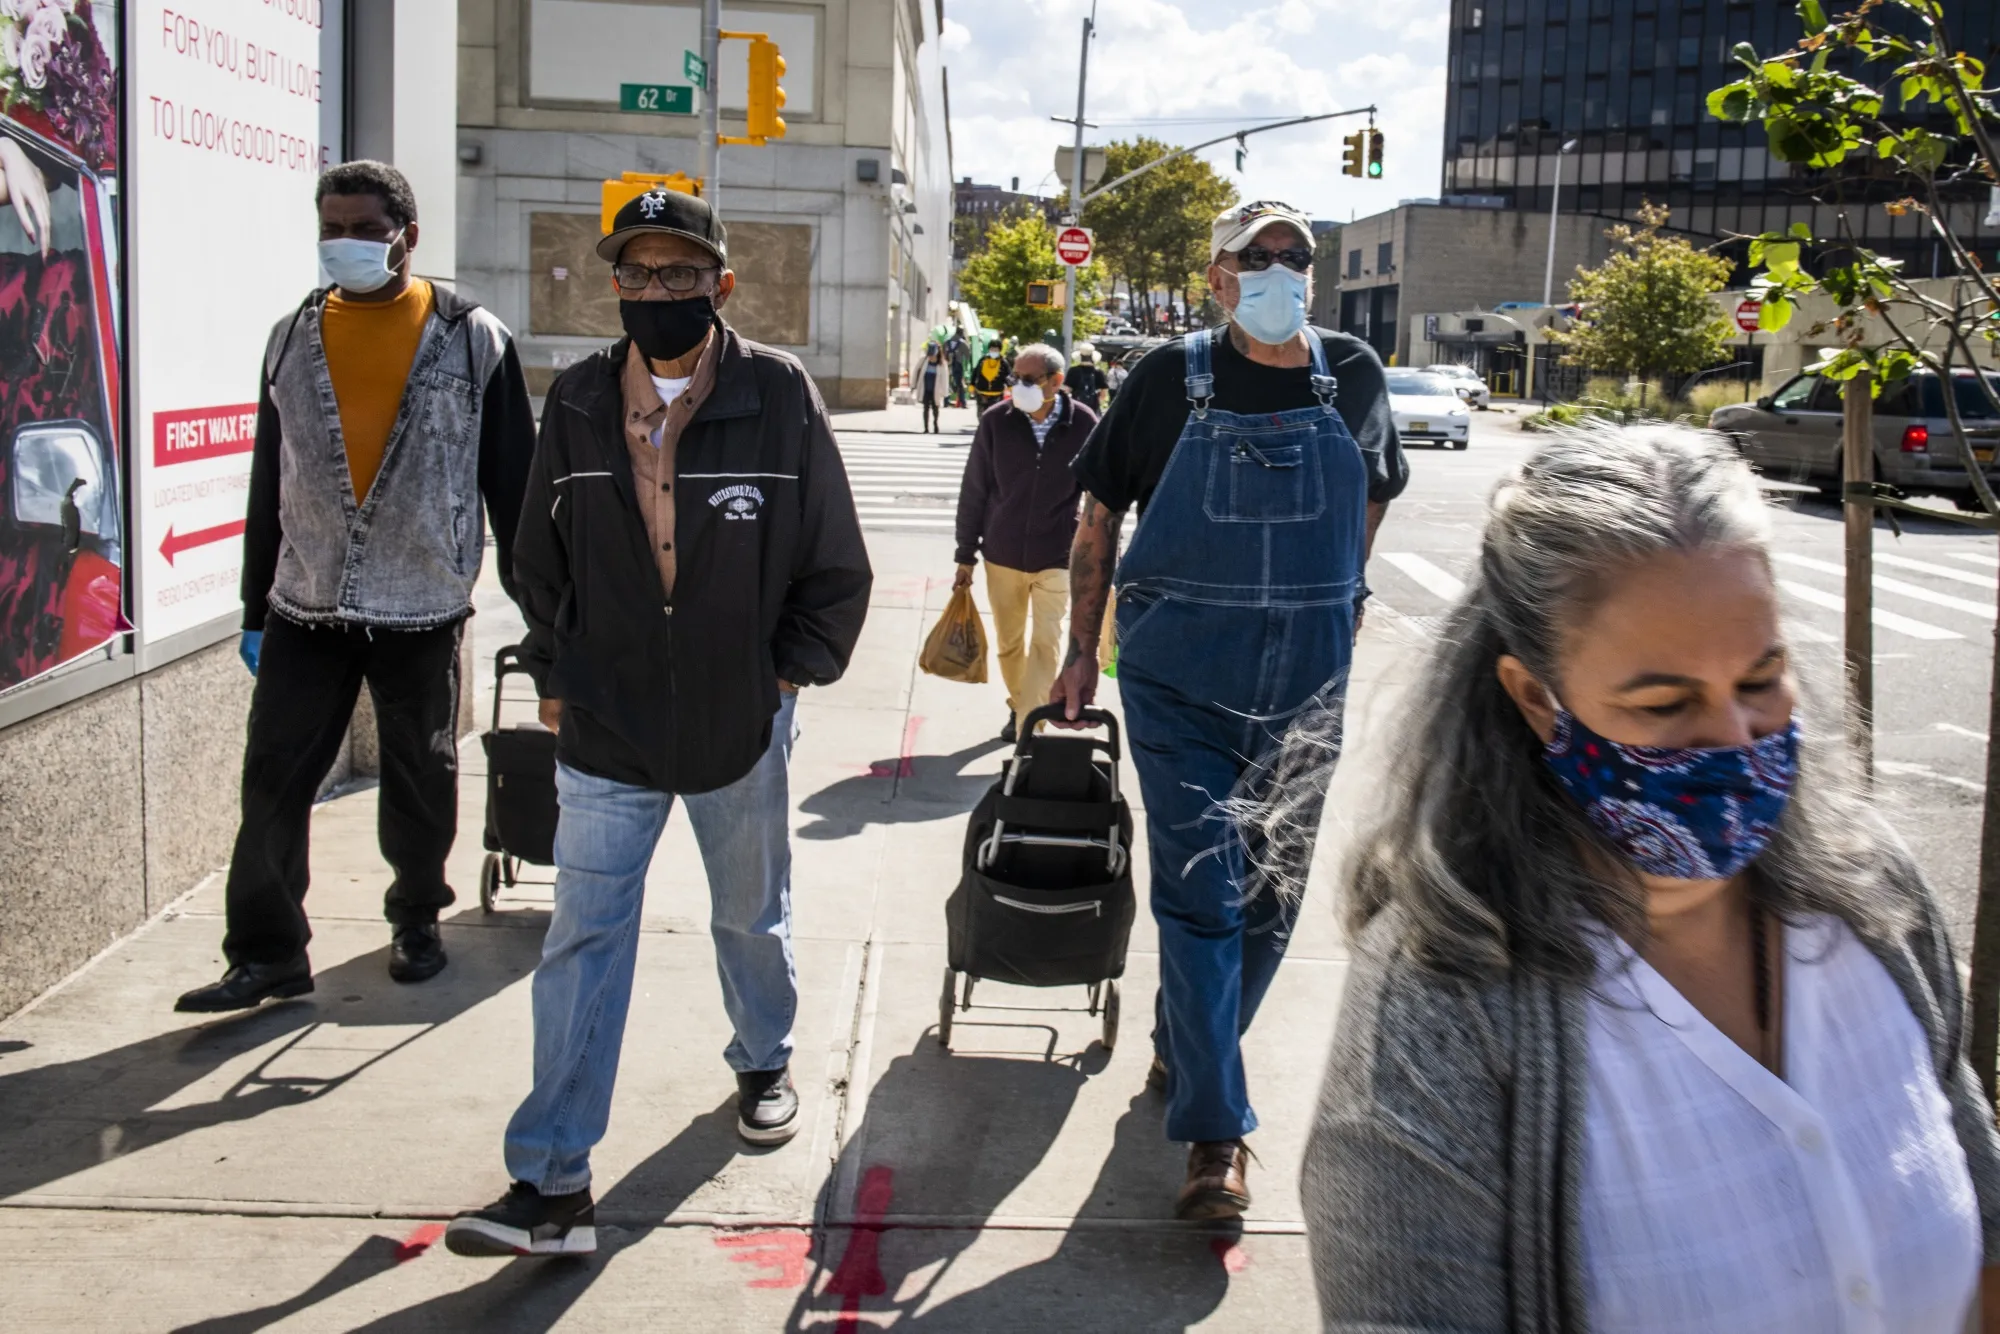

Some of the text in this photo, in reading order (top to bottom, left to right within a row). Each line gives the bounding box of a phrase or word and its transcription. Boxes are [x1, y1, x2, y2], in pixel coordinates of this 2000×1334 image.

[163, 9, 200, 59] FOR
[204, 26, 242, 81] YOU,
[247, 43, 277, 86] BUT
[288, 59, 322, 103] LOVE
[638, 88, 677, 109] 62 Dr
[150, 96, 329, 175] TO LOOK GOOD FOR ME
[166, 412, 258, 451] FIRST WAX FR
